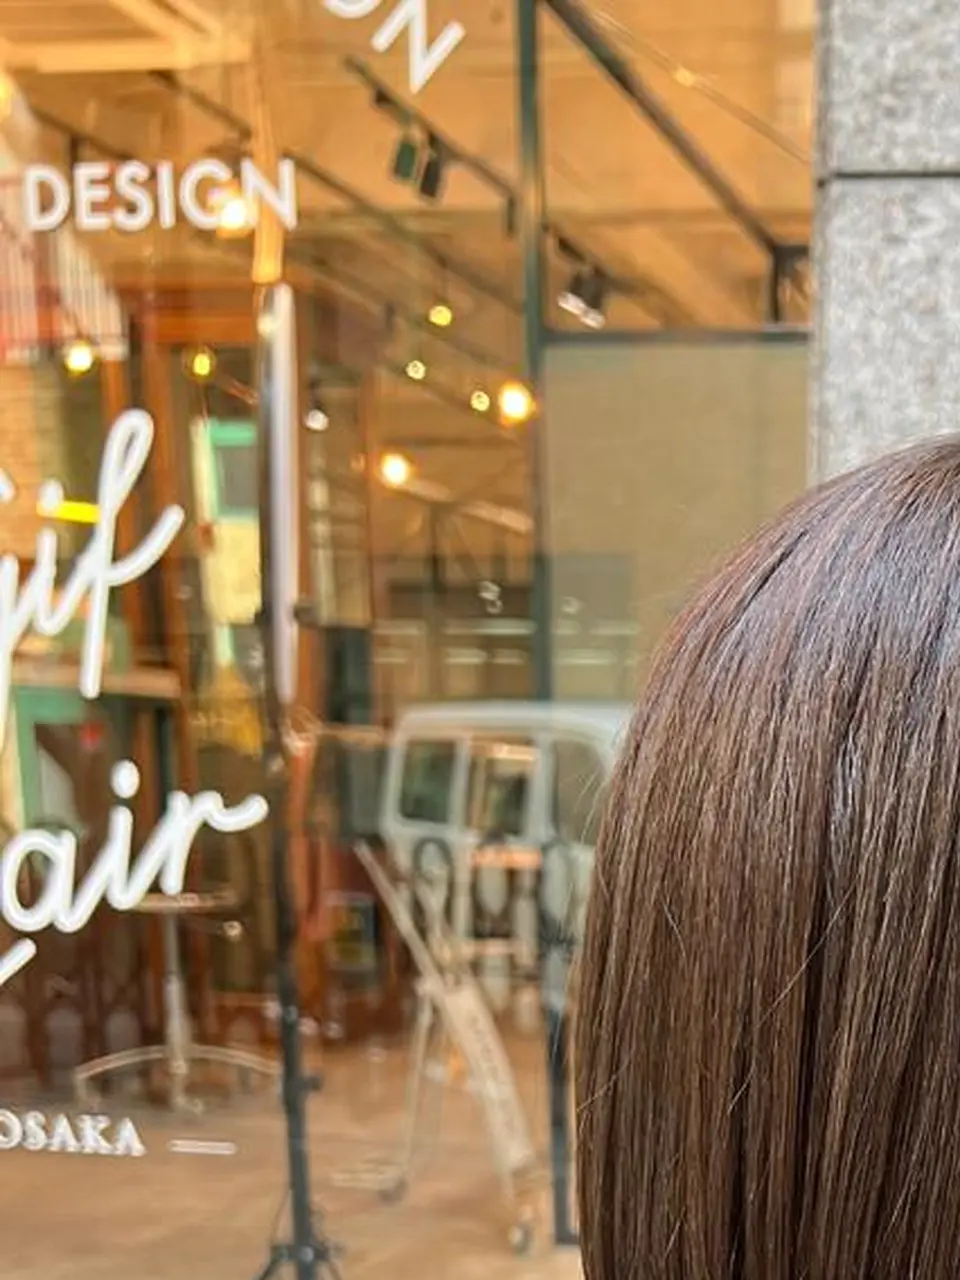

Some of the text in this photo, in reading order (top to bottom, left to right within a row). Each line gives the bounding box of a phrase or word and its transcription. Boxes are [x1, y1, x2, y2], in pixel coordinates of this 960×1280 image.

[322, 0, 467, 95] N
[23, 157, 299, 233] DESIGN
[0, 1107, 147, 1158] OSAKA
